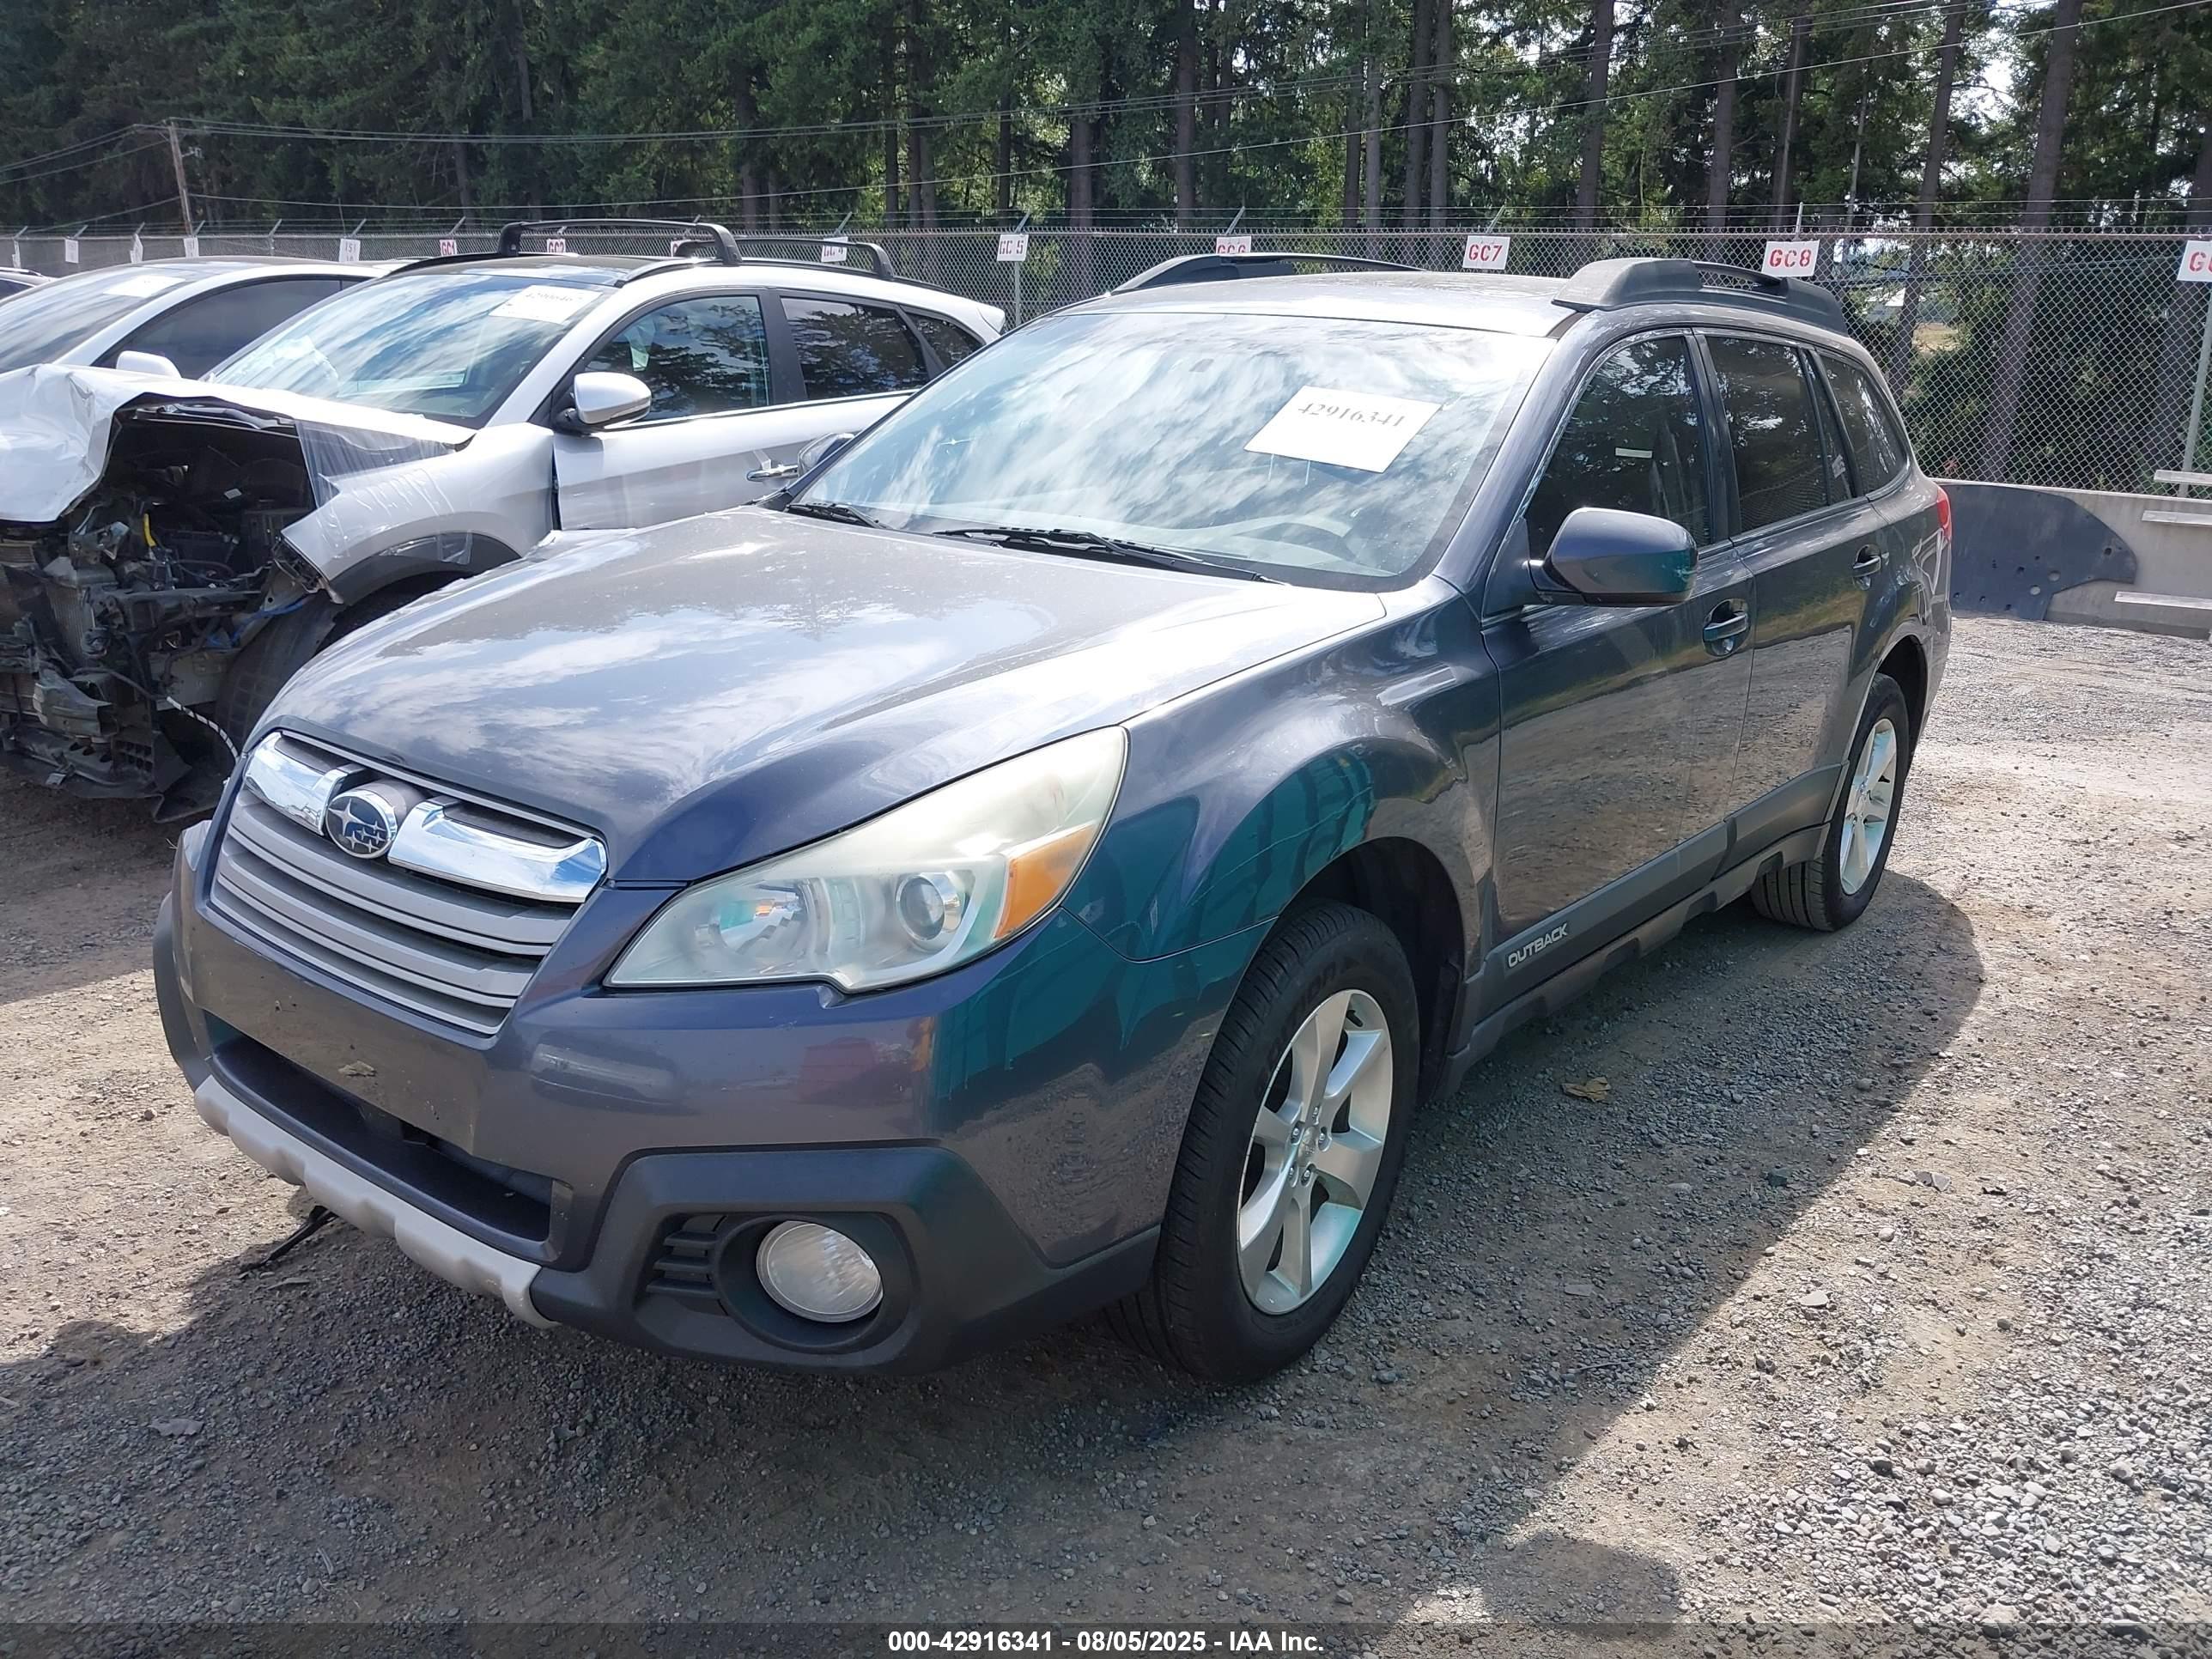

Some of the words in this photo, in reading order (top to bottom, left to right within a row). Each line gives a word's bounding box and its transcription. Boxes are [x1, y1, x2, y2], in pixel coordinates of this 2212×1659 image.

[1468, 244, 1503, 262] GC7
[1769, 248, 1812, 268] GC8
[2189, 252, 2212, 273] G
[1297, 403, 1406, 427] 42916341
[1508, 922, 1568, 968] OUTBACK
